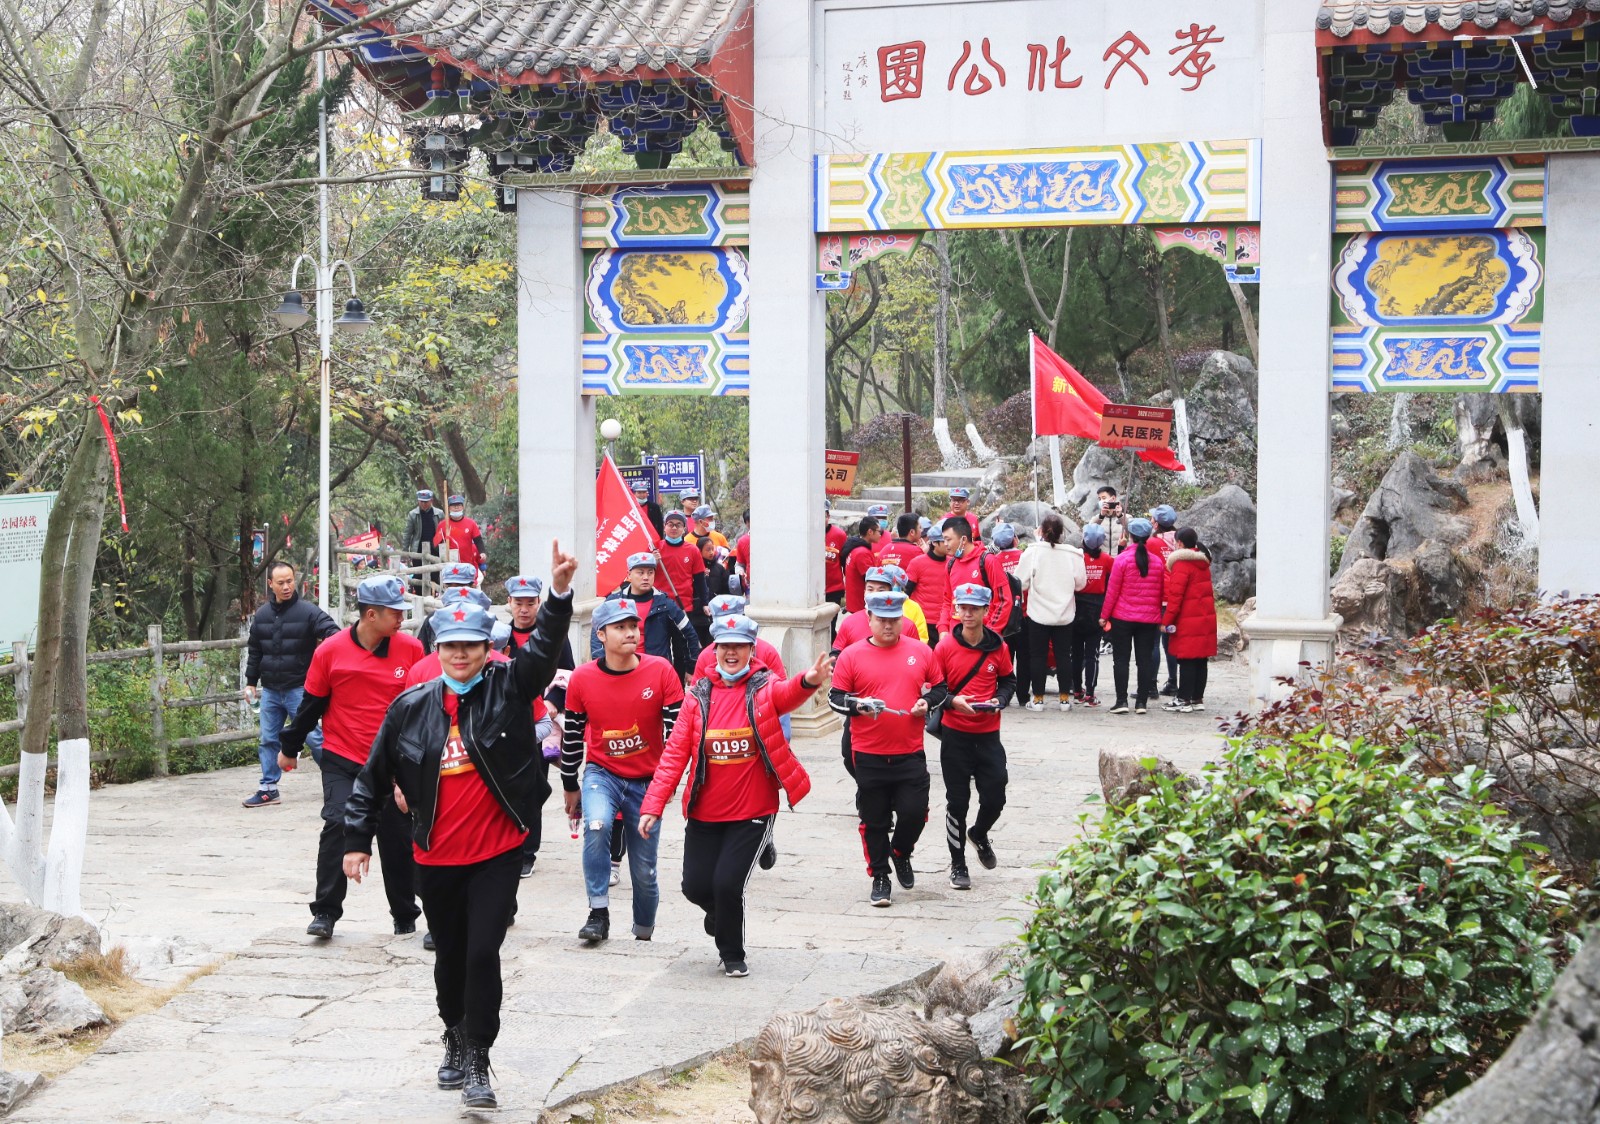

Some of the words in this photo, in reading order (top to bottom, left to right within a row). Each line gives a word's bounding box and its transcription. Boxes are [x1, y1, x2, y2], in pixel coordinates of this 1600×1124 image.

[1107, 424, 1164, 440] 人民医院
[608, 735, 643, 750] 0302
[712, 739, 749, 753] 0199
